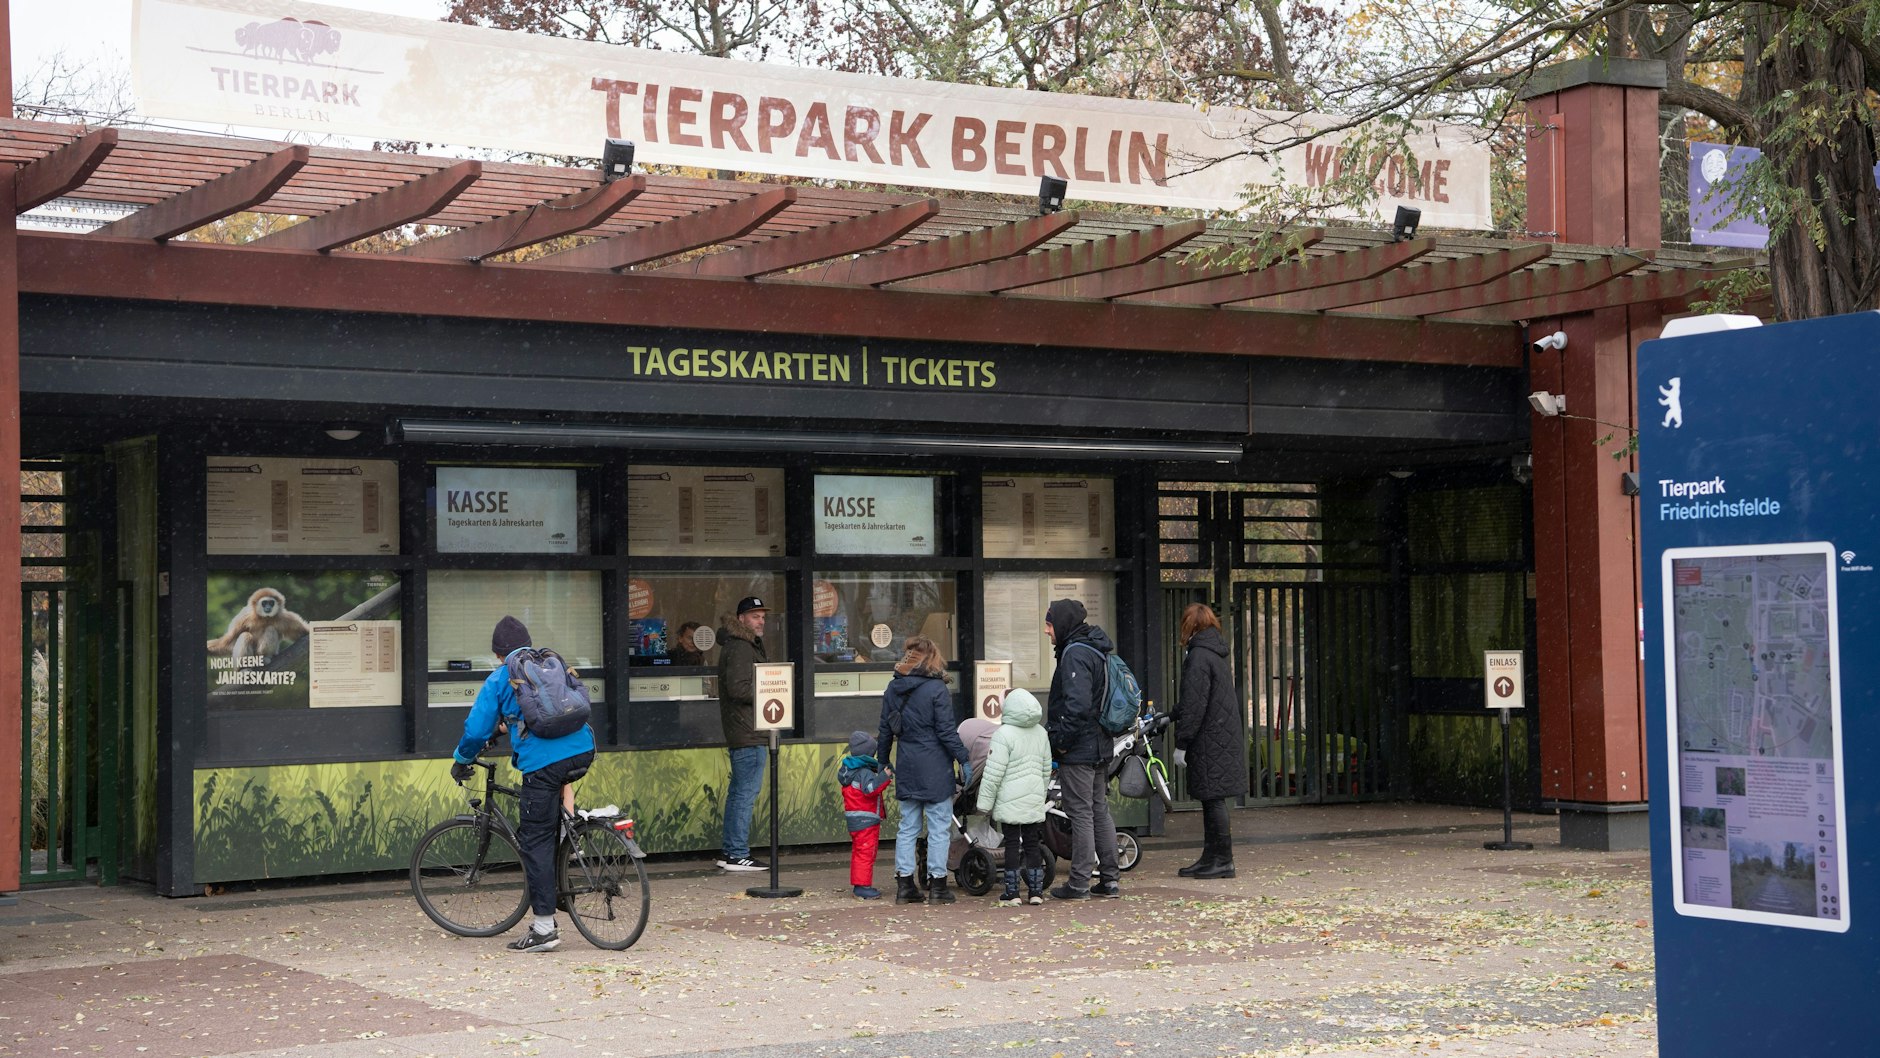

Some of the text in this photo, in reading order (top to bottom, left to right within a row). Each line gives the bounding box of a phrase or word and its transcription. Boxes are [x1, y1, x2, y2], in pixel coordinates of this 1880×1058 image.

[210, 66, 361, 107] TIERPARK
[254, 103, 331, 123] BERLIN
[590, 77, 1169, 187] TIERPARK BERLIN
[626, 346, 851, 382] TAGESKARTEN
[881, 356, 997, 388] TICKETS
[1659, 476, 1726, 499] Tierpark
[447, 490, 509, 513] KASSE
[823, 496, 876, 518] KASSE
[1660, 497, 1781, 521] Friedrichsfelde
[448, 518, 544, 528] Tageskarten & Jahreskarten
[824, 521, 906, 532] Tageskarten & Jahreskarten
[210, 655, 265, 670] NOCH KEENE
[1489, 658, 1517, 667] EINLASS
[215, 670, 297, 686] JAHRESKARTE?
